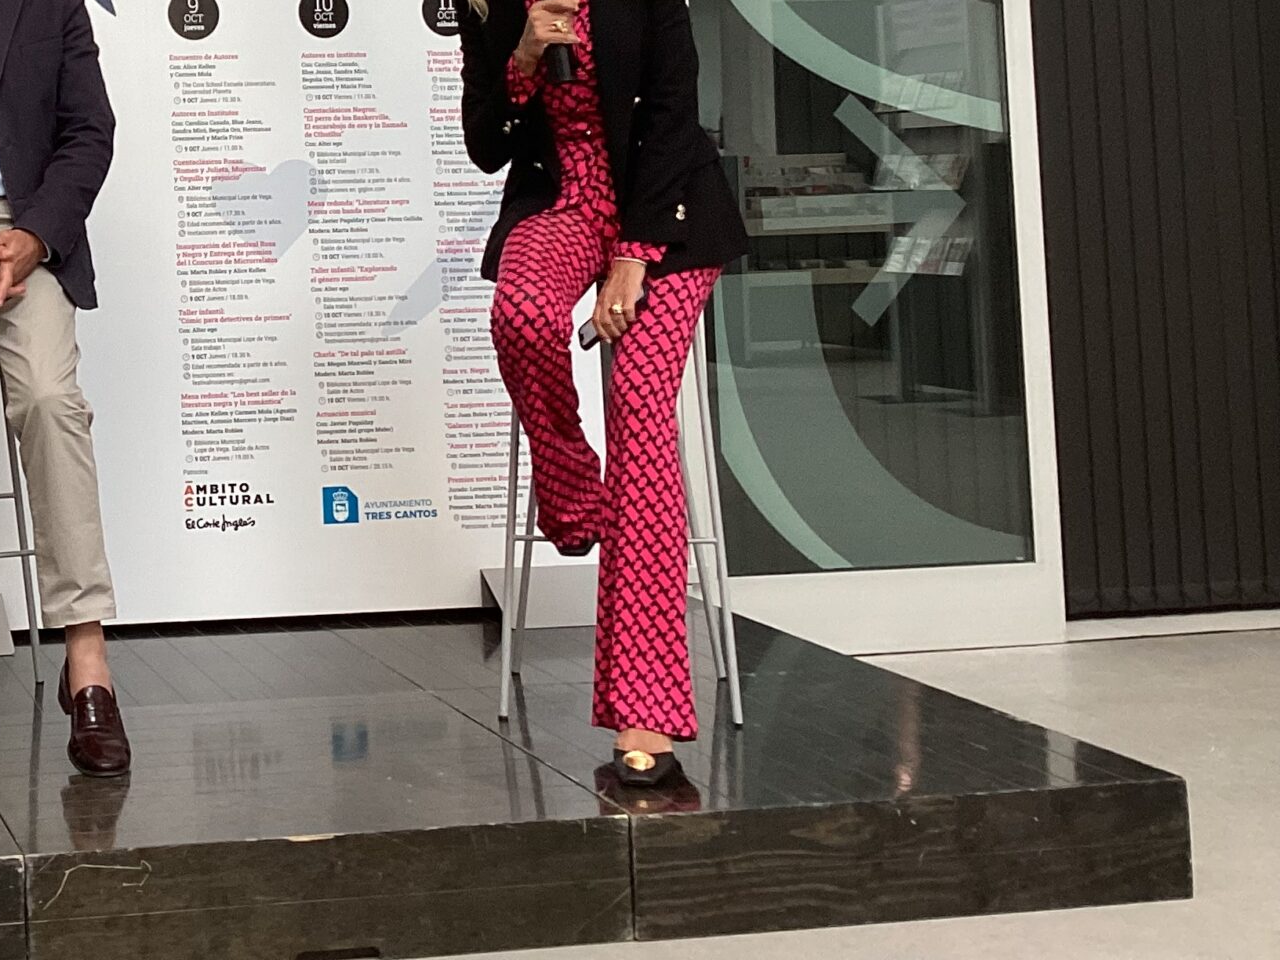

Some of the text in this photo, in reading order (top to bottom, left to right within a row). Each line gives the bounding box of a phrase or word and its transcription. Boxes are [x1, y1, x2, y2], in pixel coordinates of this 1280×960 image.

[183, 13, 205, 23] OCT
[314, 12, 334, 21] OCT
[437, 10, 457, 20] OCT
[184, 493, 275, 507] CULTURAL
[364, 498, 433, 509] AYUNTAMIENTO
[365, 509, 438, 521] TRES CANTOS
